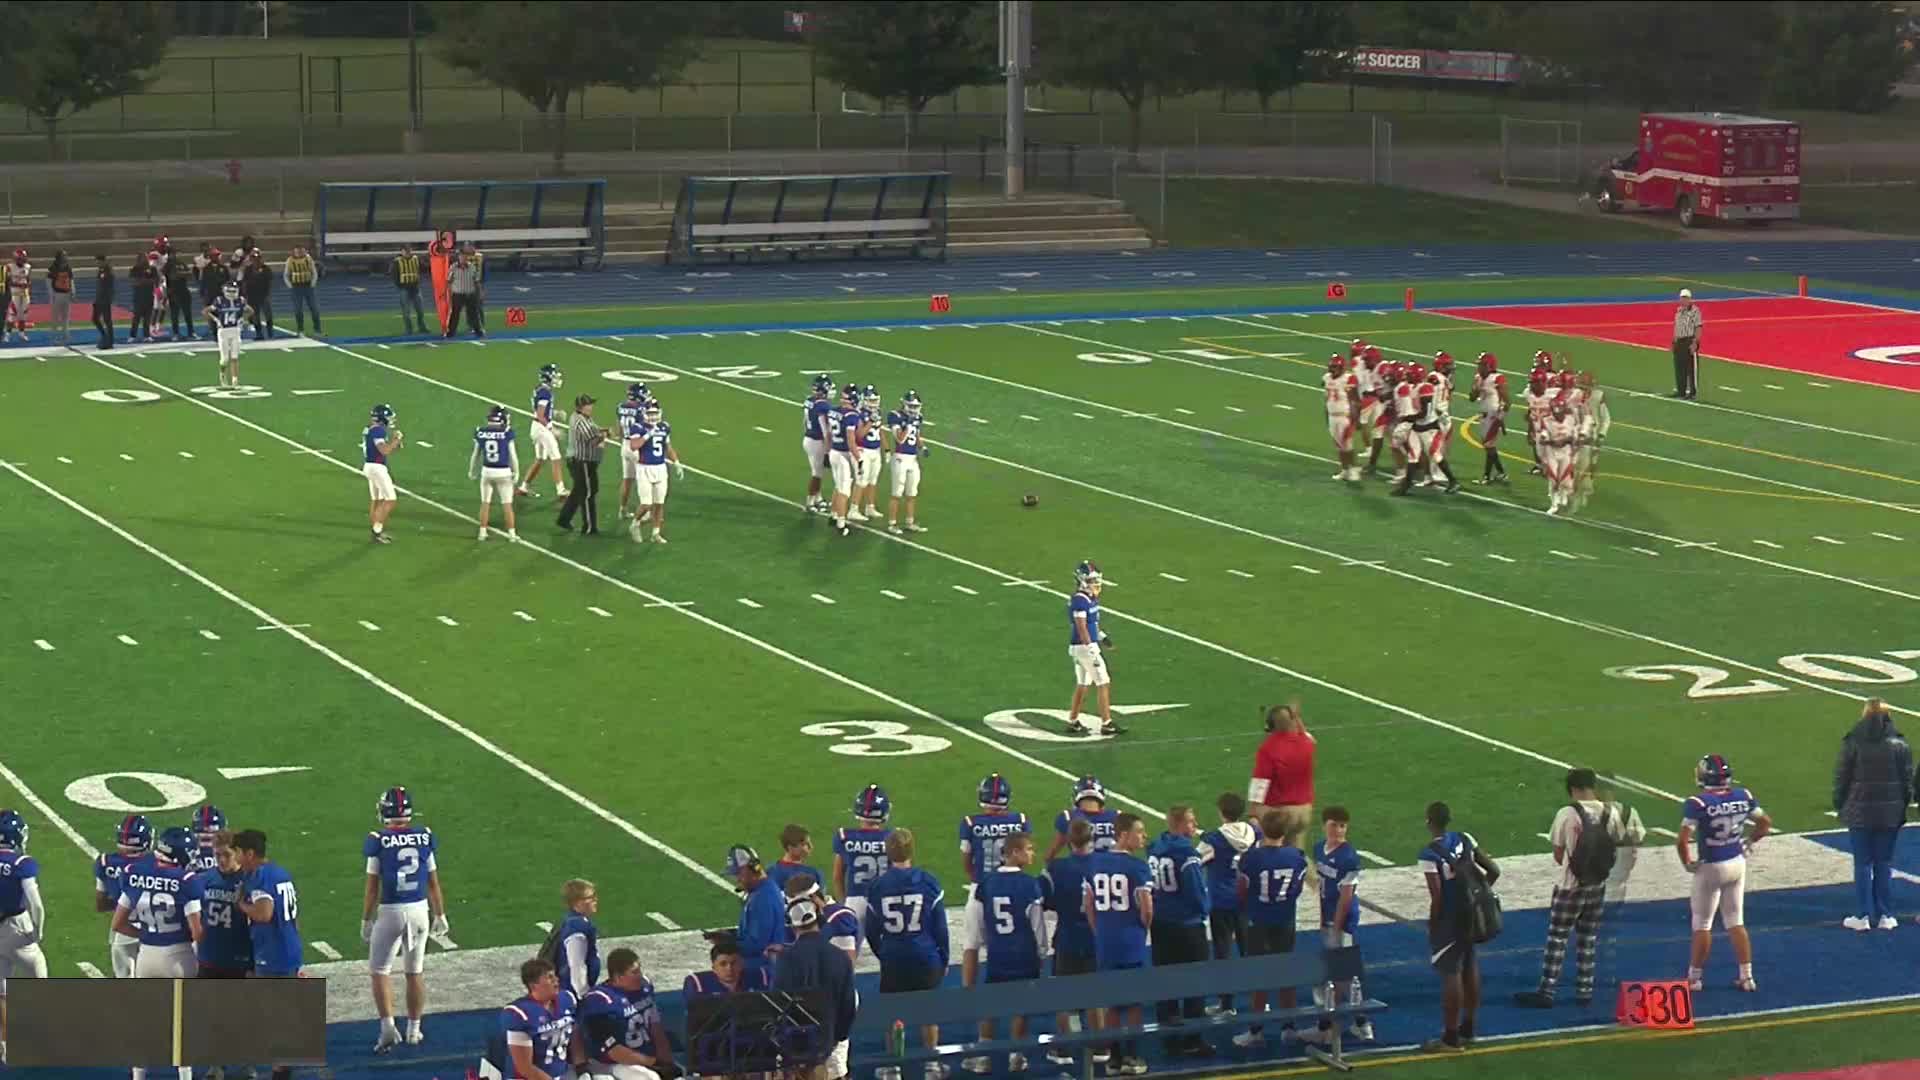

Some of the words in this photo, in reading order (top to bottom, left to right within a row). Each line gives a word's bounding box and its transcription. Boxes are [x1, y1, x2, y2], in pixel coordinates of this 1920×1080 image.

[1368, 53, 1421, 69] SOCCER
[224, 311, 236, 325] 14
[477, 431, 507, 440] CADETS
[485, 440, 500, 463] 8
[652, 436, 664, 457] 5
[1707, 801, 1749, 816] CADETS
[381, 833, 430, 848] CADETS
[973, 823, 1022, 837] CADETS
[845, 840, 886, 854] CADET
[397, 847, 419, 892] 2
[129, 874, 180, 892] CADETS
[1093, 873, 1130, 912] 99
[1259, 868, 1295, 903] 17
[129, 891, 181, 933] 42
[207, 901, 233, 929] 54
[881, 893, 924, 933] 57
[993, 896, 1015, 935] 5
